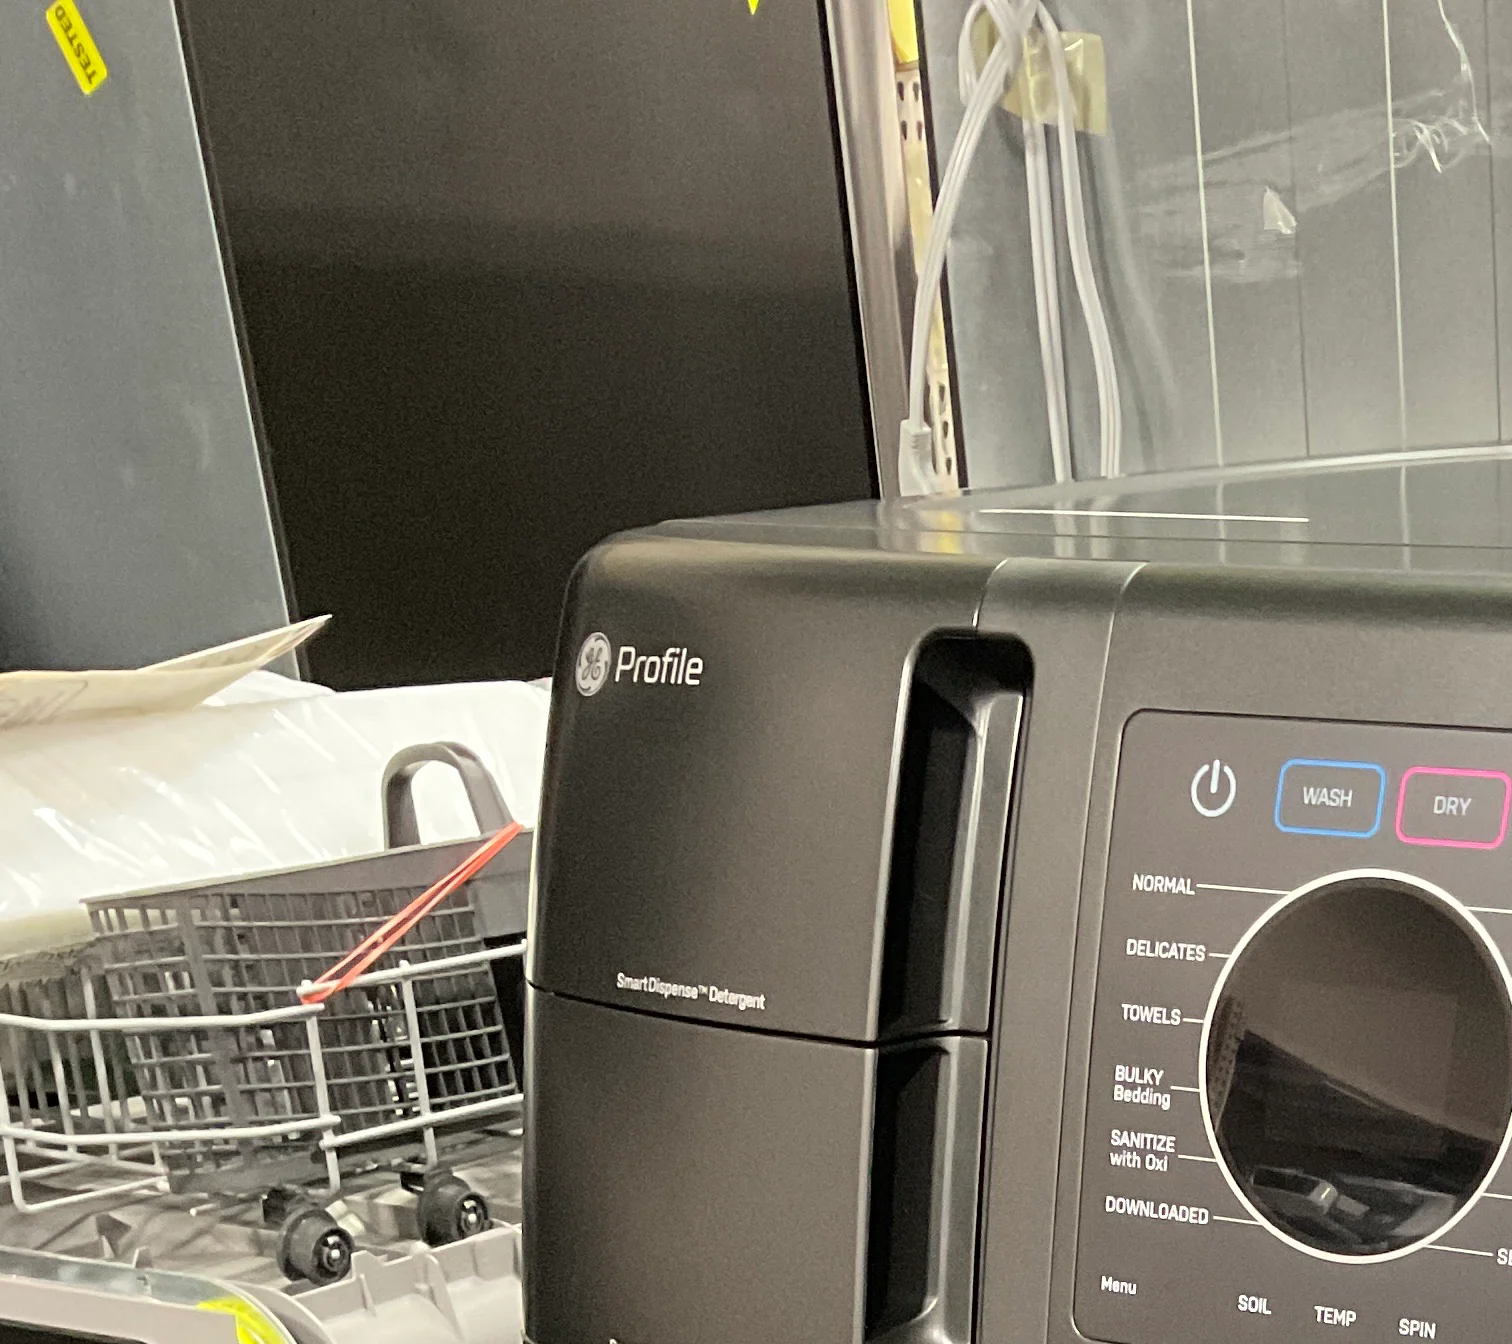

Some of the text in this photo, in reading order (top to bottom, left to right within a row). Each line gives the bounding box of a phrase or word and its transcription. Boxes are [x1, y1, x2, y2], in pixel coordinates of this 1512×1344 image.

[55, 5, 96, 85] TESTED
[615, 645, 703, 686] Profile
[1302, 786, 1353, 808] WASH
[1433, 795, 1472, 815] DRY
[1133, 873, 1196, 896] NORMAL
[1126, 939, 1207, 963] DELICATES
[708, 985, 766, 1011] Detergent
[1121, 1003, 1181, 1026] TOWELS
[1114, 1065, 1164, 1087] BULKY
[1113, 1085, 1171, 1111] Bedding
[1110, 1130, 1176, 1154] SANITIZE
[1109, 1150, 1169, 1172] with Oxi
[1105, 1197, 1209, 1226] DOWNLOADED
[1101, 1275, 1136, 1296] Menu
[1237, 1294, 1272, 1315] SOIL
[1313, 1305, 1357, 1327] TEMP
[1398, 1317, 1437, 1340] SPIN
